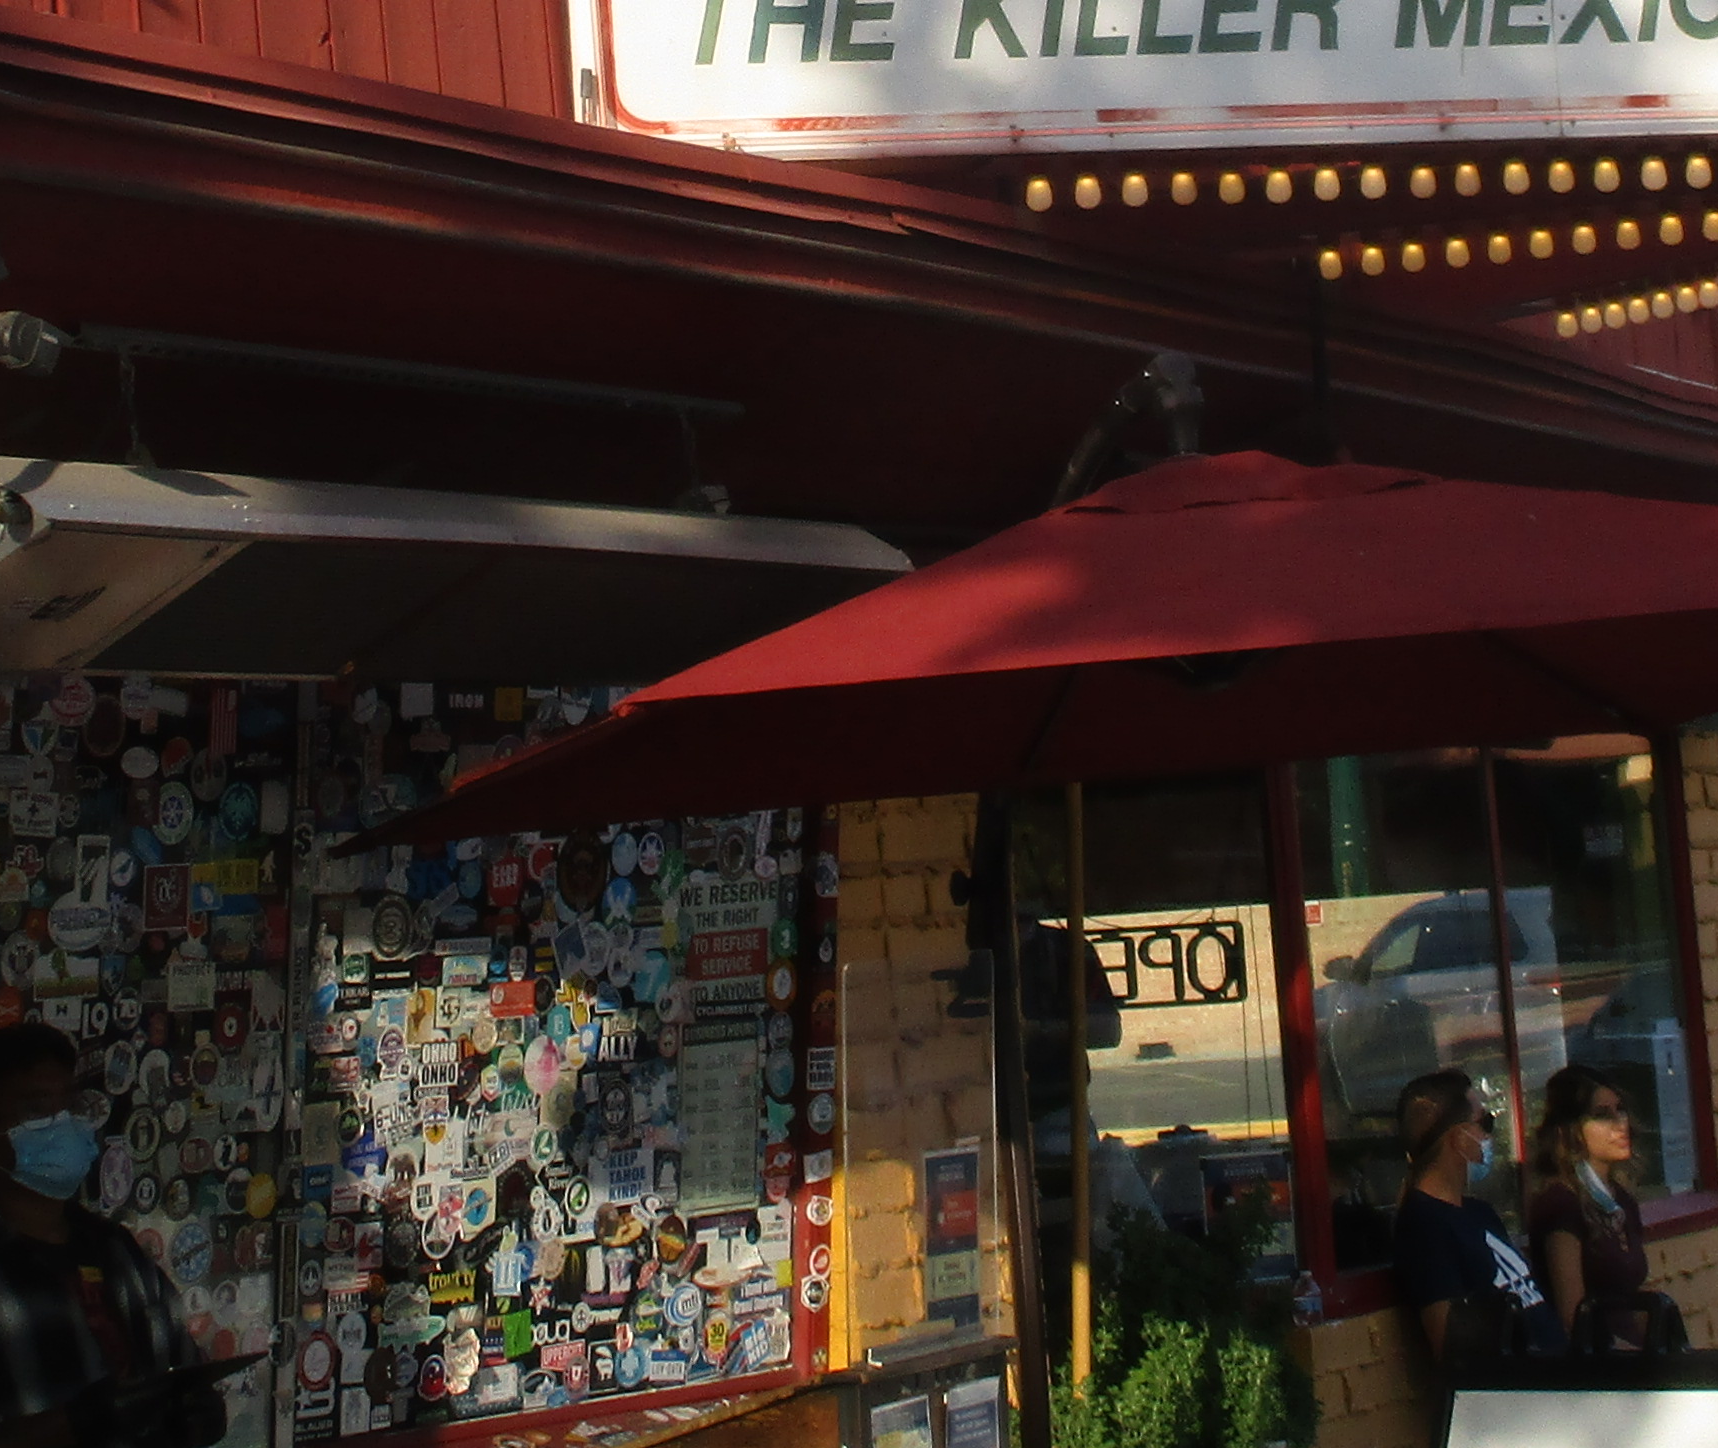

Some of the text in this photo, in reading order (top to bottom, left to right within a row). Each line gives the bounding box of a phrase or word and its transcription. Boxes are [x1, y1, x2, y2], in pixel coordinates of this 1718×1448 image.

[680, 880, 778, 908] WE RESERVE
[695, 908, 760, 928] THE RIGHT
[693, 934, 761, 954] TO REFUSE
[701, 954, 753, 976] SERVICE
[691, 980, 761, 1003] TO ANYONE
[598, 1036, 637, 1062] ALLY
[609, 1152, 639, 1169] KEEP
[609, 1166, 646, 1184] TAHOE
